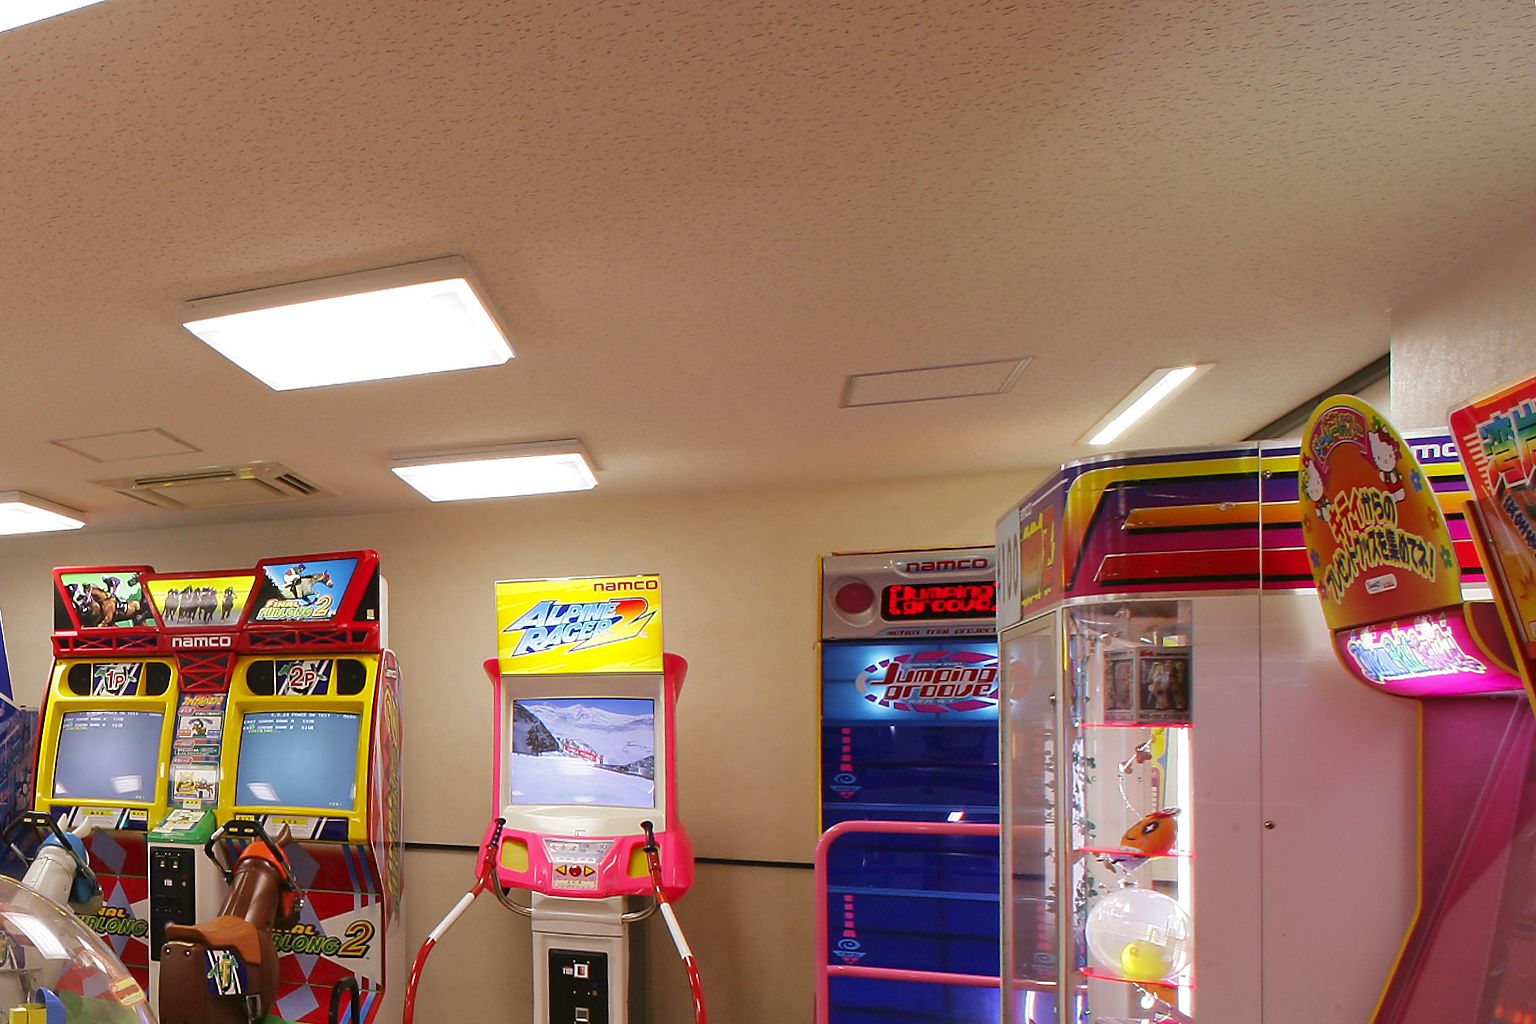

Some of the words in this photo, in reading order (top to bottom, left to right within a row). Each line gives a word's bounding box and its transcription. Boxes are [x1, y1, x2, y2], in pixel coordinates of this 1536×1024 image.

[906, 558, 988, 572] namco
[593, 580, 658, 592] namco
[312, 595, 334, 617] 2
[503, 600, 620, 633] ALPINE
[172, 636, 232, 648] namco
[512, 619, 615, 656] RACER
[104, 669, 125, 690] 1P
[289, 666, 315, 687] 2P
[870, 662, 998, 685] Jumping
[884, 683, 993, 700] groove
[338, 919, 376, 958] 2
